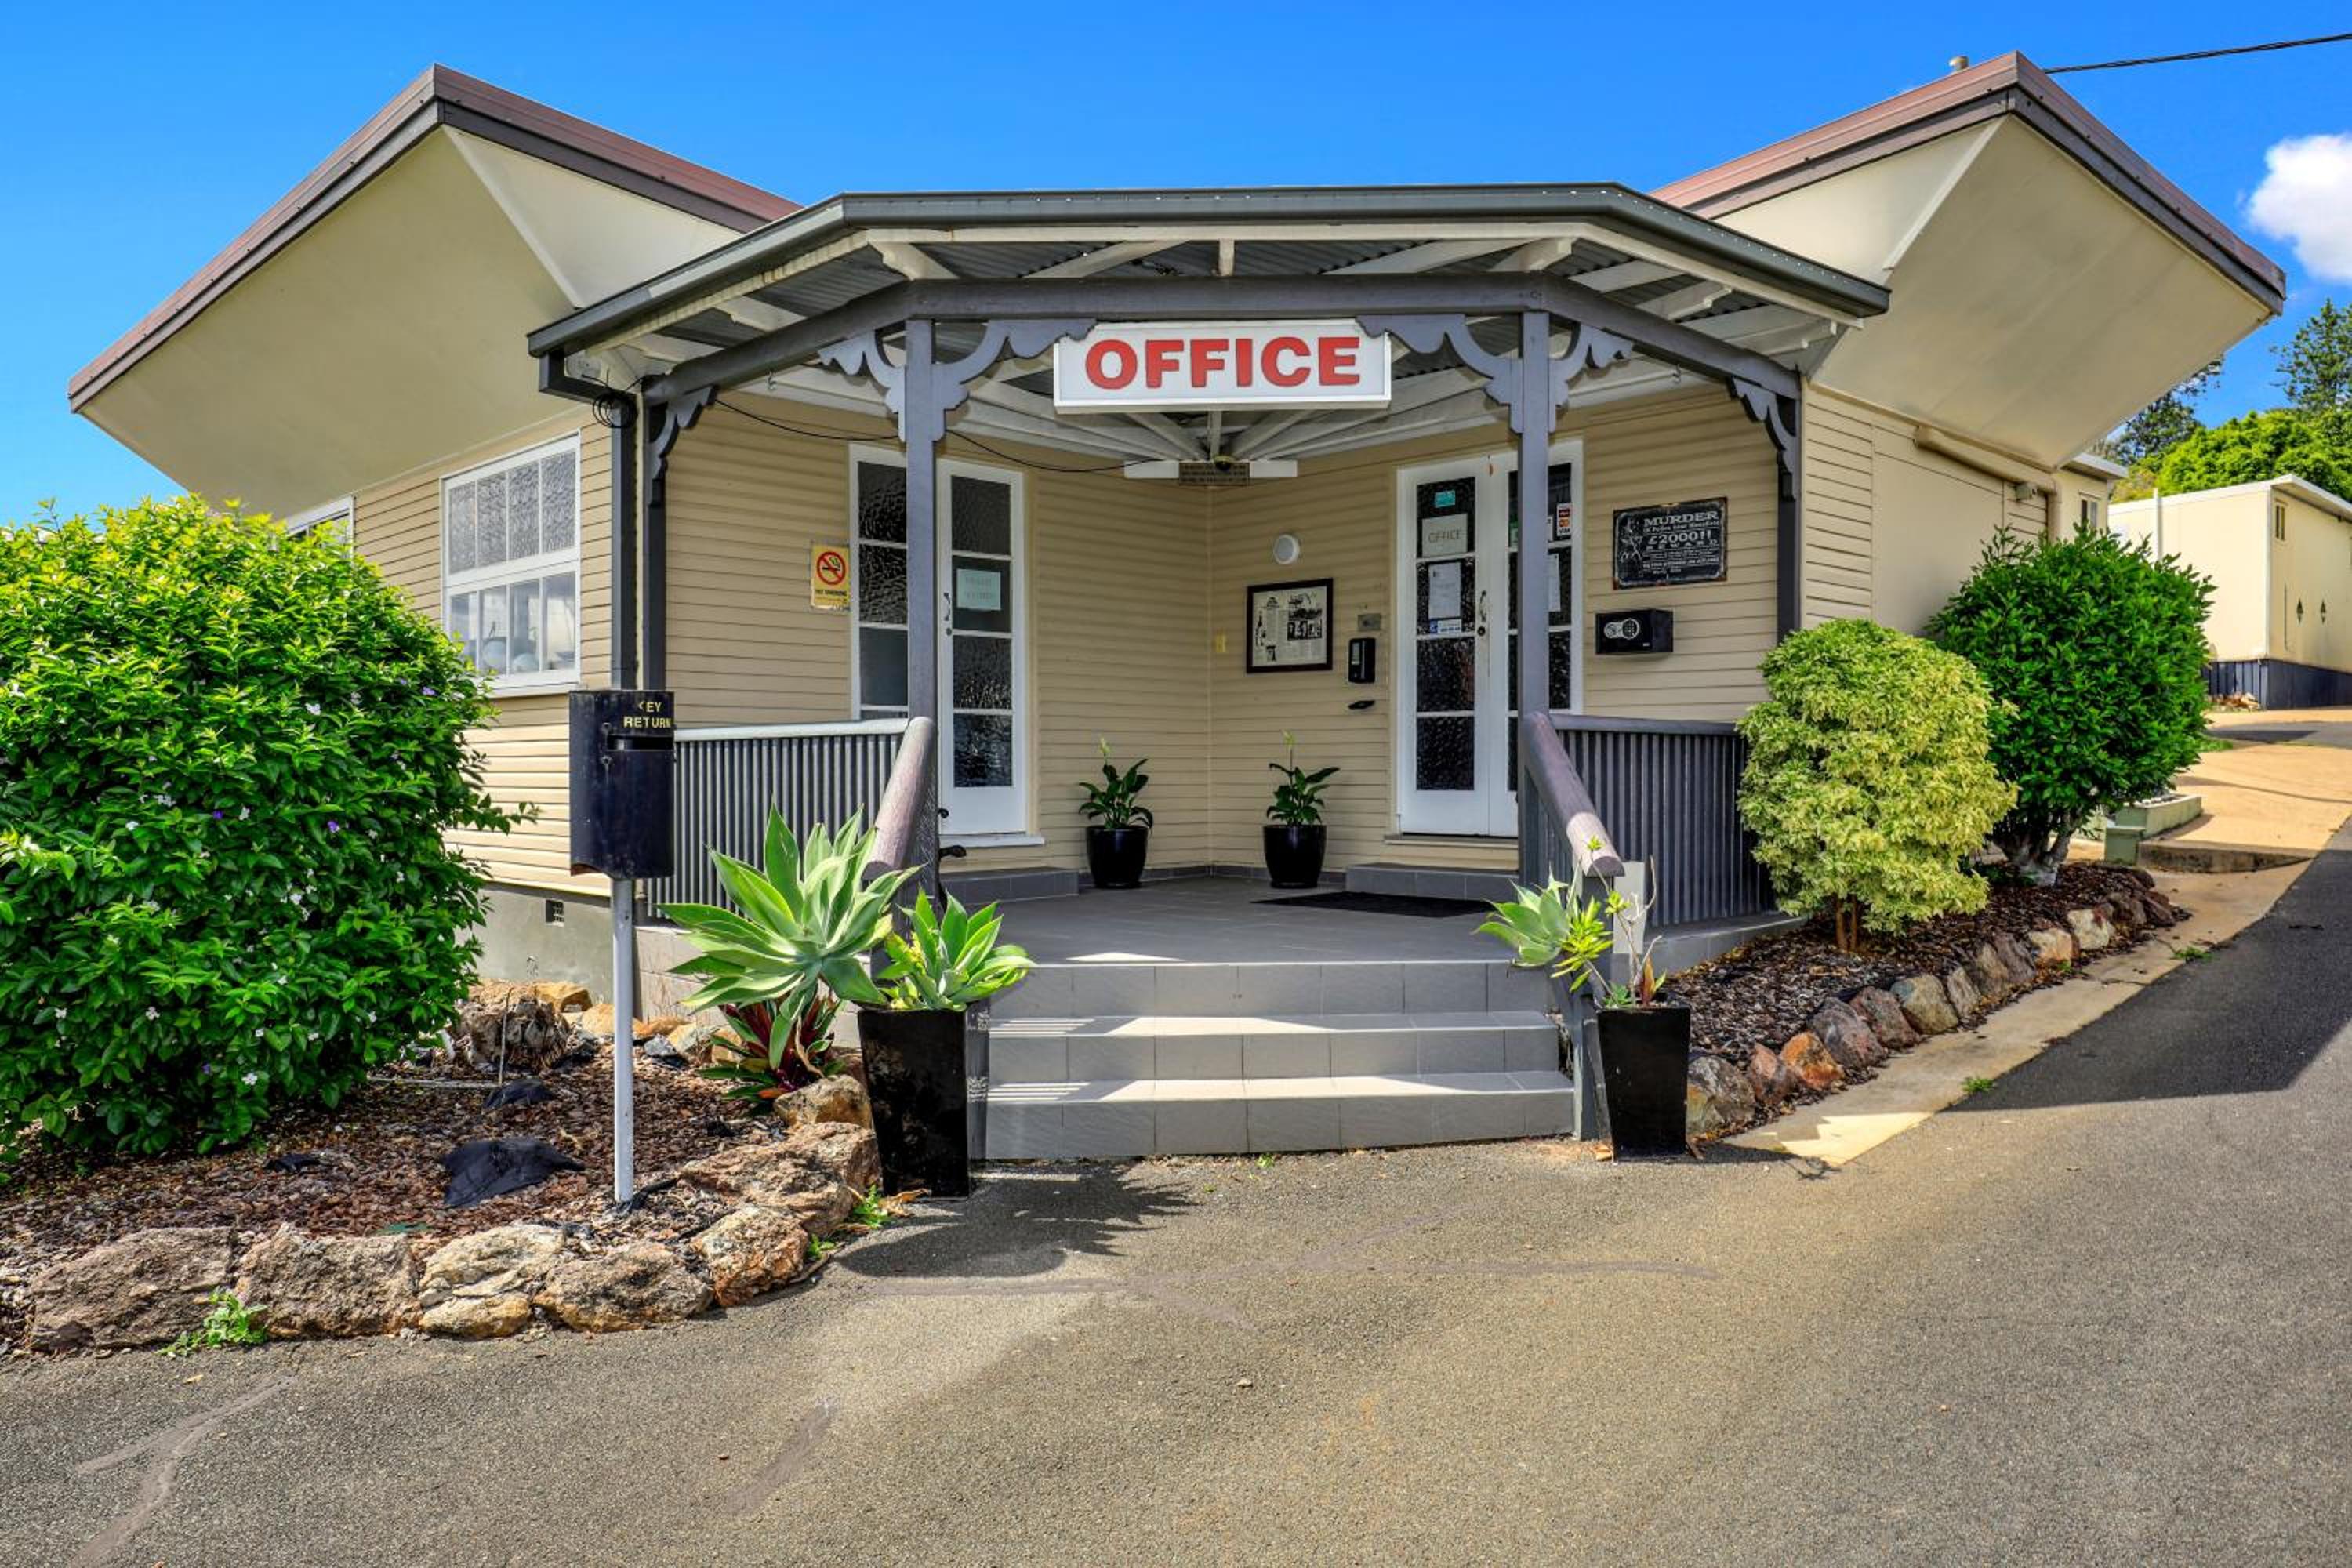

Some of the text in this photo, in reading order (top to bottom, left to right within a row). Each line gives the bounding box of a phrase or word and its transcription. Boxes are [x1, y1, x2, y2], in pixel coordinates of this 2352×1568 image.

[1085, 336, 1360, 390] OFFICE
[1644, 511, 1719, 527] MURDER
[623, 716, 671, 728] RETURN
